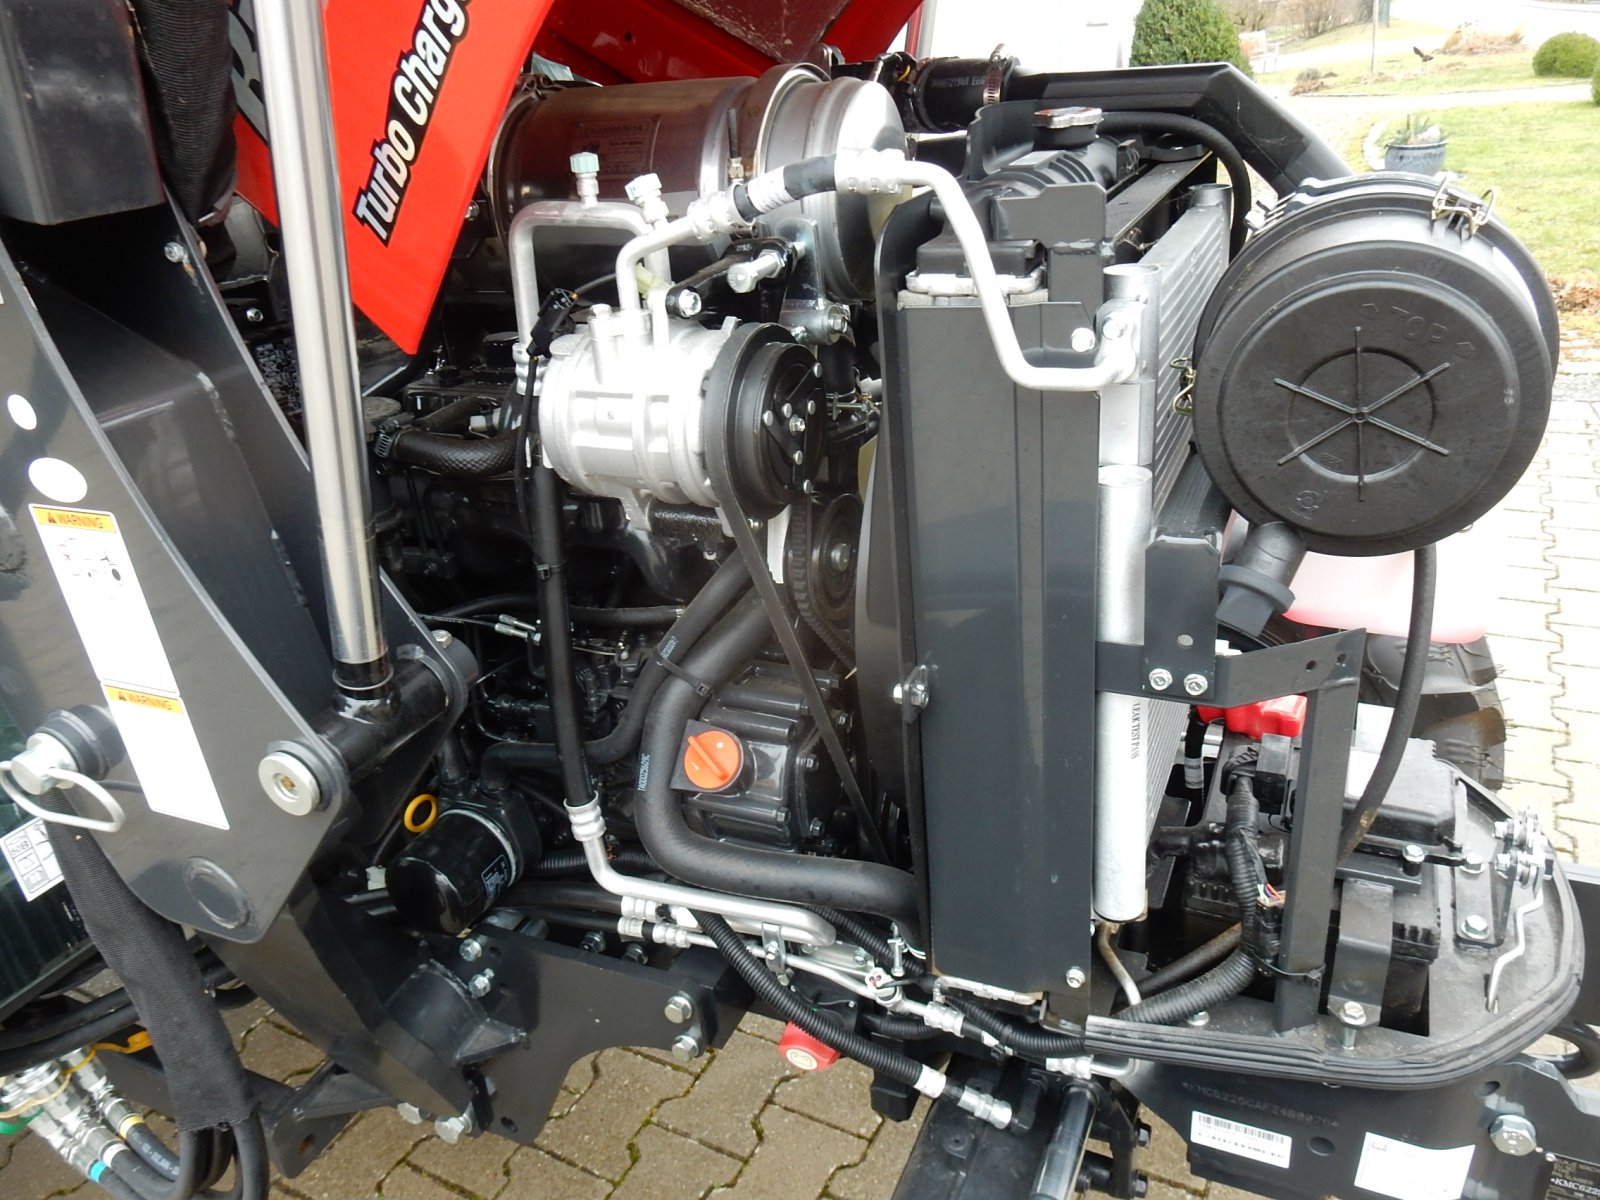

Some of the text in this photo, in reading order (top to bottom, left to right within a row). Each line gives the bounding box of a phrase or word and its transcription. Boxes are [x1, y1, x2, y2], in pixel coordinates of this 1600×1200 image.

[356, 0, 466, 240] Turbo Charg
[58, 512, 104, 529] WARNING
[127, 693, 172, 711] WARNING
